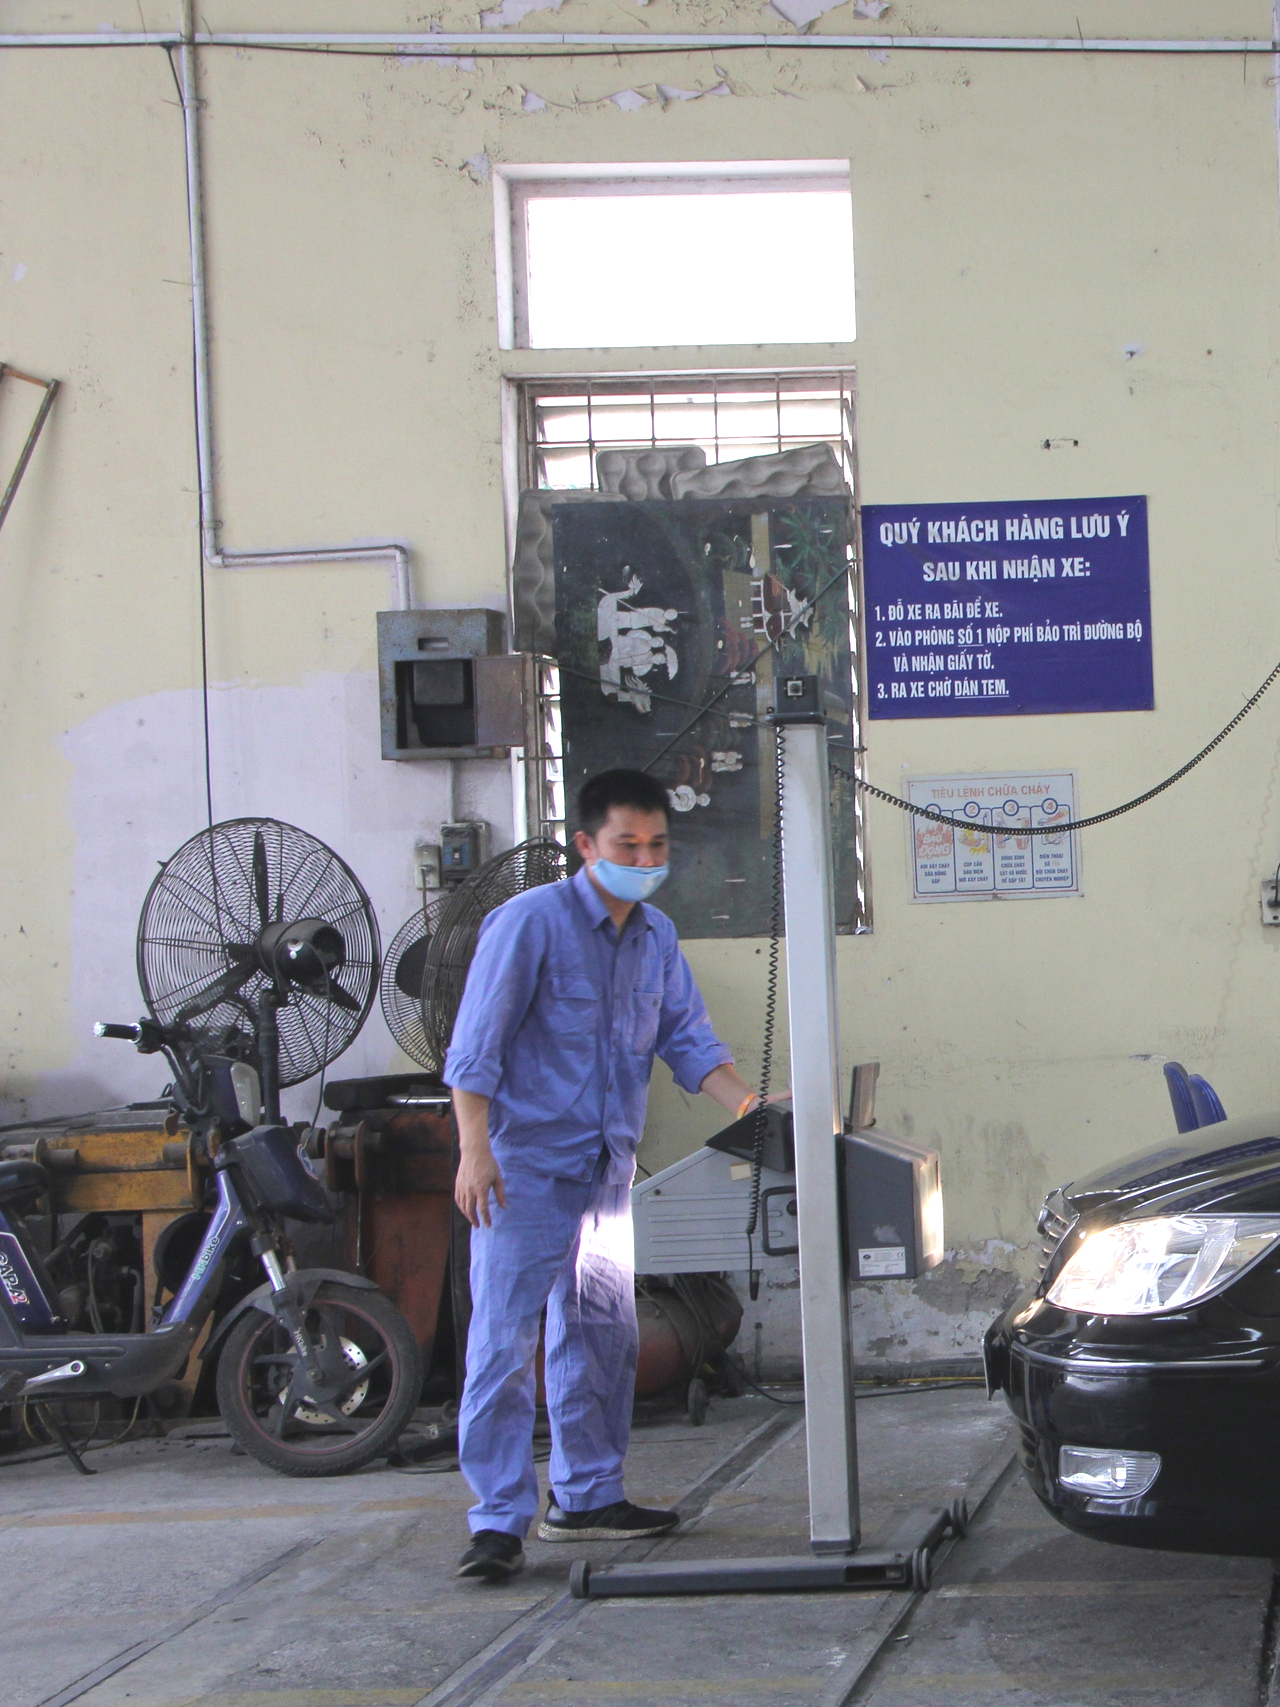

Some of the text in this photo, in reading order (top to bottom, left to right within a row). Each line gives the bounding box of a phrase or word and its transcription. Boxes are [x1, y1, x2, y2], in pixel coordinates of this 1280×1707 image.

[880, 510, 1129, 546] QUÝ KHÁCH HÀNG LƯU Ý
[923, 555, 1091, 582] SAU KHI NHẬN XE:
[874, 596, 1003, 621] 1. ĐỖ XE RA BÃI ĐỂ XE.
[875, 619, 1142, 647] 2. VÀO PHÒNG SỐ 1 NỘP PHÍ BẢO TRÌ ĐƯỜNG BỘ
[893, 649, 995, 674] VÀ NHẬN GIẤY TỜ.
[877, 677, 1009, 698] 3. RA XE CHỜ DÁN TEM.
